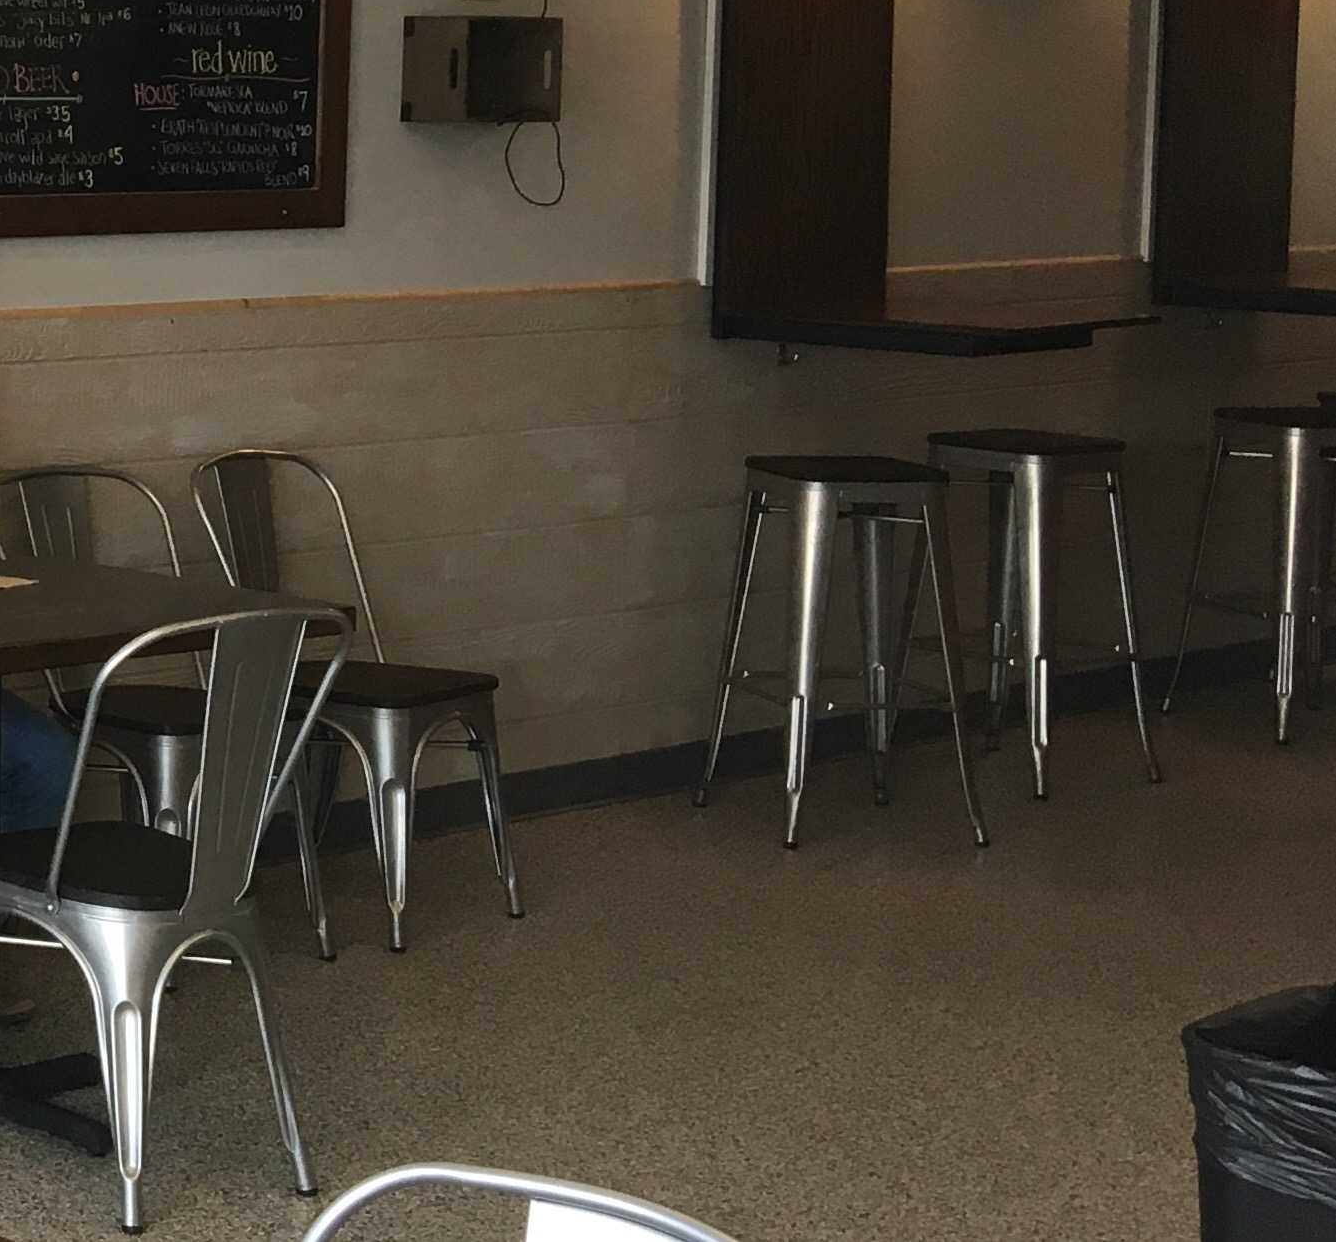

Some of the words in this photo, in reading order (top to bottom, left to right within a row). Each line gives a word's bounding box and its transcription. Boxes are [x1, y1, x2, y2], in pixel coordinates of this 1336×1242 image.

[191, 39, 224, 74] red
[227, 44, 279, 74] wine
[15, 63, 70, 94] BEER
